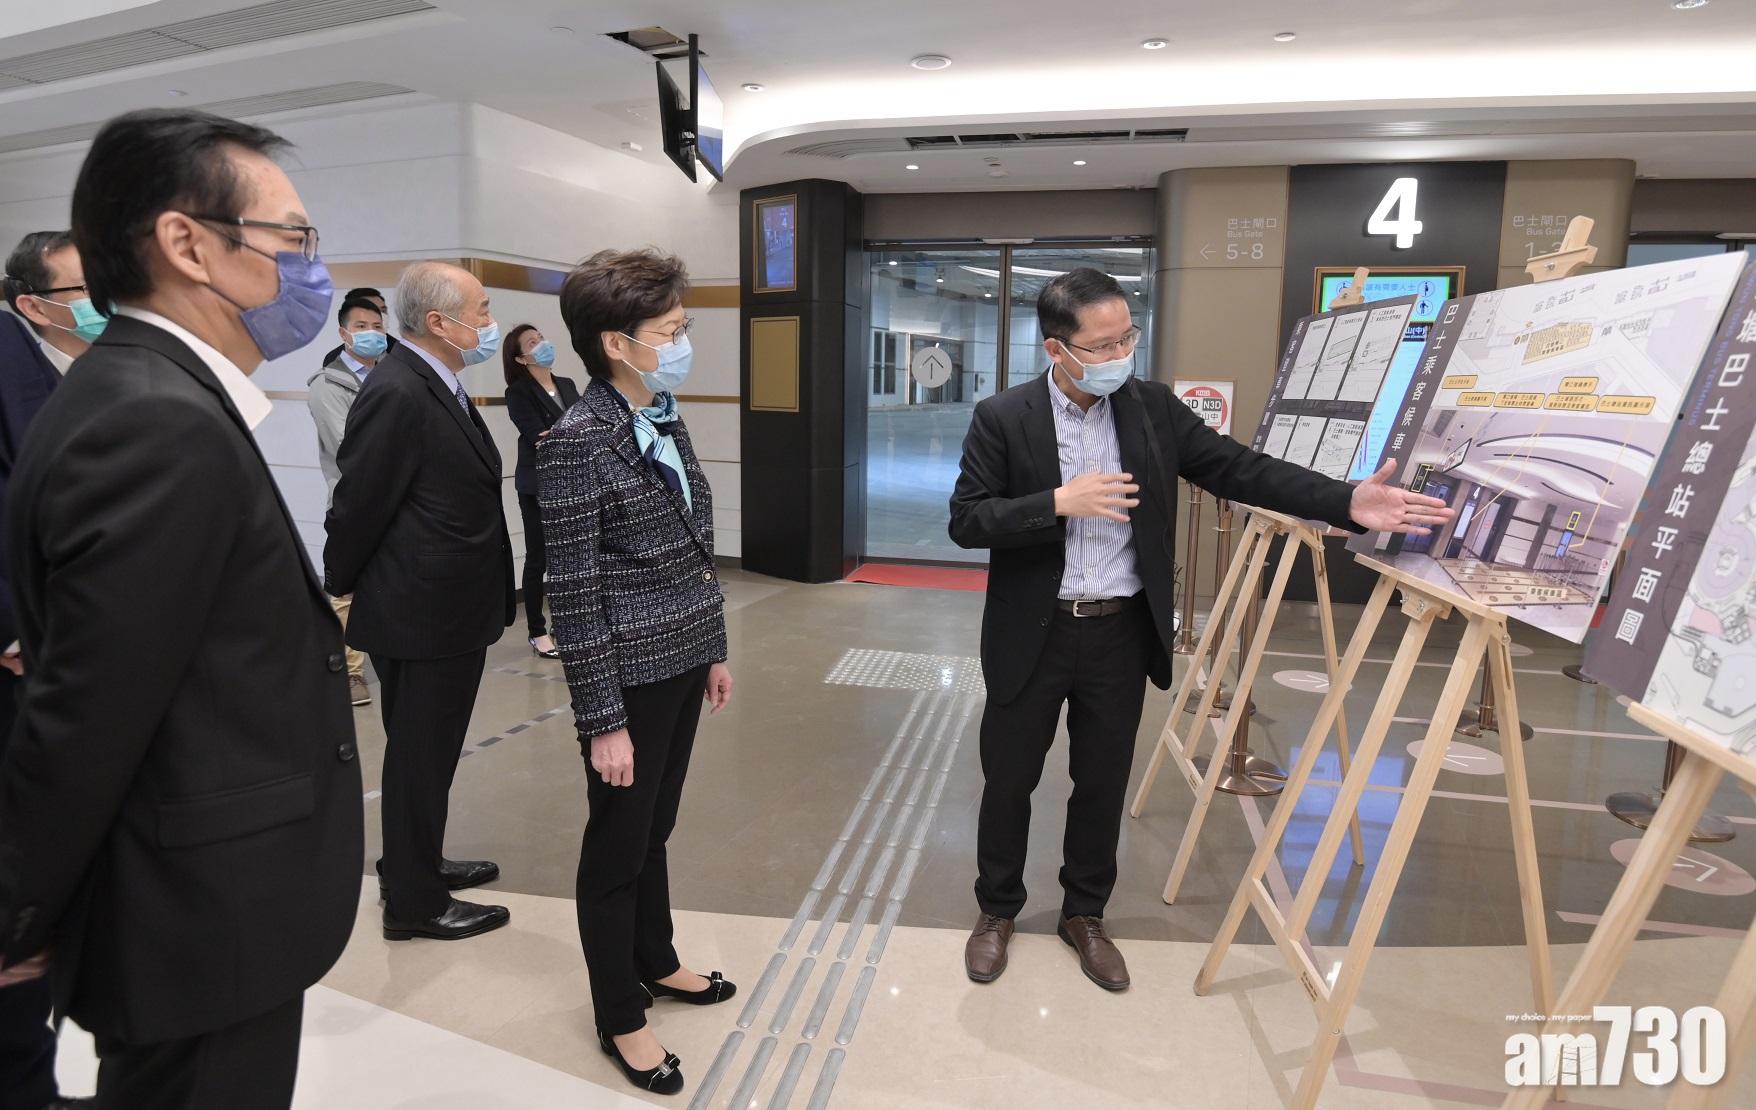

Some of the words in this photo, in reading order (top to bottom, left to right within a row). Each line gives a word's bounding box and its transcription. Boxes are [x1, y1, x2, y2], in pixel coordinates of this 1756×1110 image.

[1367, 177, 1423, 249] 4
[1227, 217, 1277, 230] 巴士閘口
[1513, 215, 1567, 227] 巴士閘口
[1227, 230, 1243, 238] Bus
[1244, 230, 1263, 238] Gate
[1526, 228, 1543, 236] Bus
[1226, 243, 1264, 260] 5-8
[1386, 303, 1460, 461] 巴士乘客候車
[1203, 400, 1222, 410] N3D
